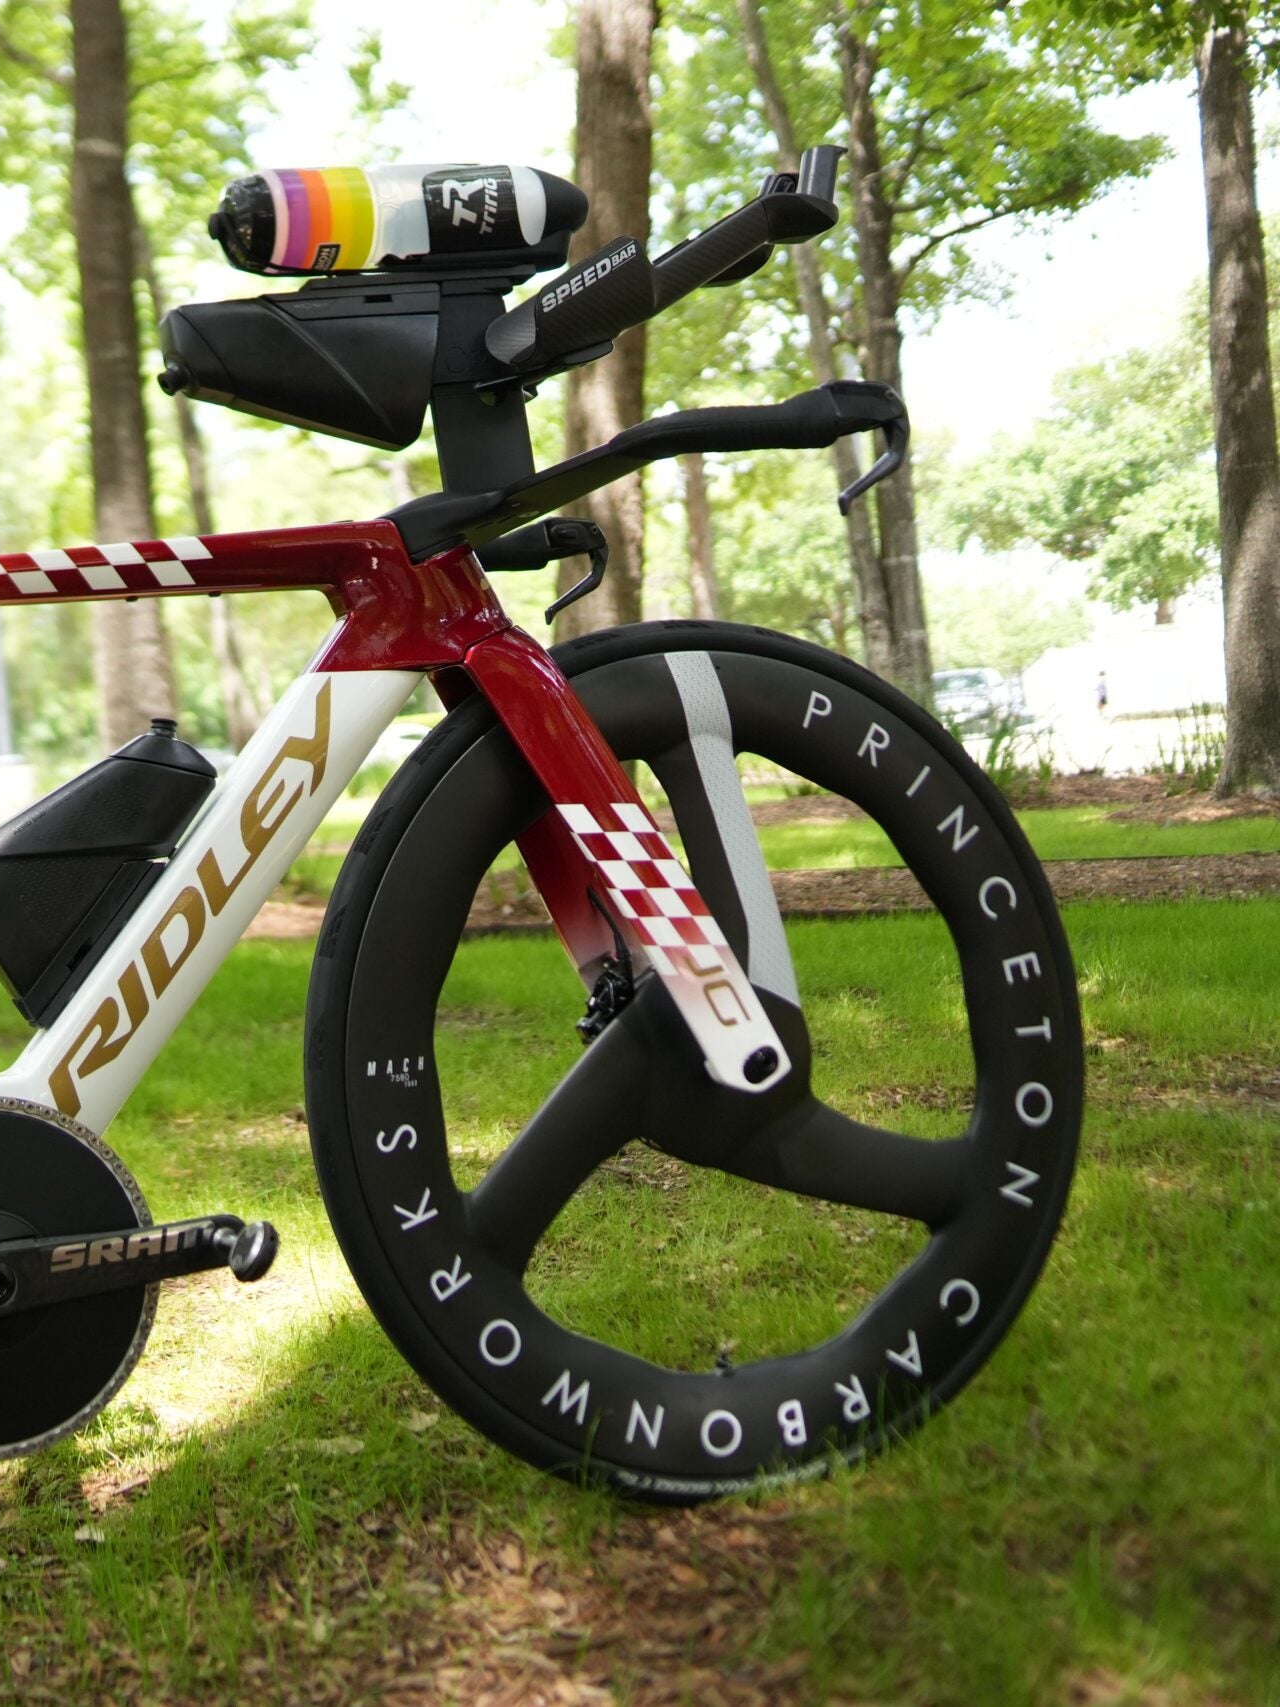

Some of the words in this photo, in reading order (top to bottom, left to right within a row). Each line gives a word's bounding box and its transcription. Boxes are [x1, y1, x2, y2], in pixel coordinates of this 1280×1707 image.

[48, 675, 332, 1118] RIDLEY
[803, 690, 1054, 1208] PRINCETON
[367, 1056, 424, 1076] MACH
[51, 1220, 215, 1273] SRAM
[376, 1123, 592, 1426] WORKS
[624, 1278, 981, 1458] CARBON
